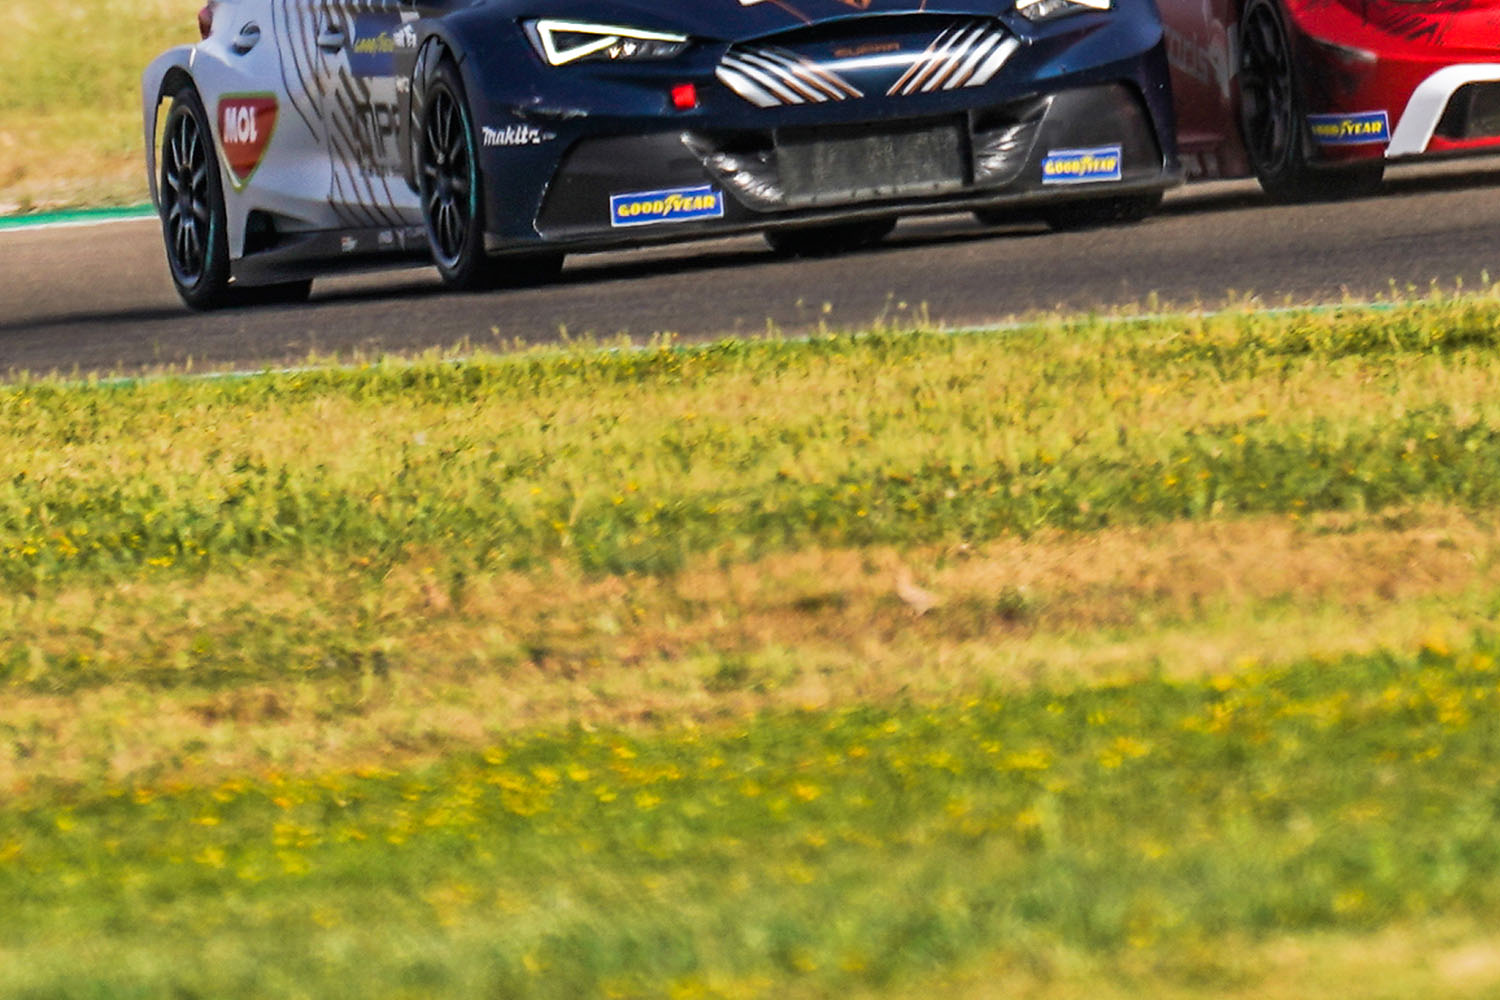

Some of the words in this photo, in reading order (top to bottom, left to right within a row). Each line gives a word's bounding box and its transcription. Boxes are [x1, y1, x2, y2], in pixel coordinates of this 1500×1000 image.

[223, 106, 258, 144] MOL
[1044, 154, 1117, 177] GOODYEAR
[616, 193, 716, 217] GOODYEAR
